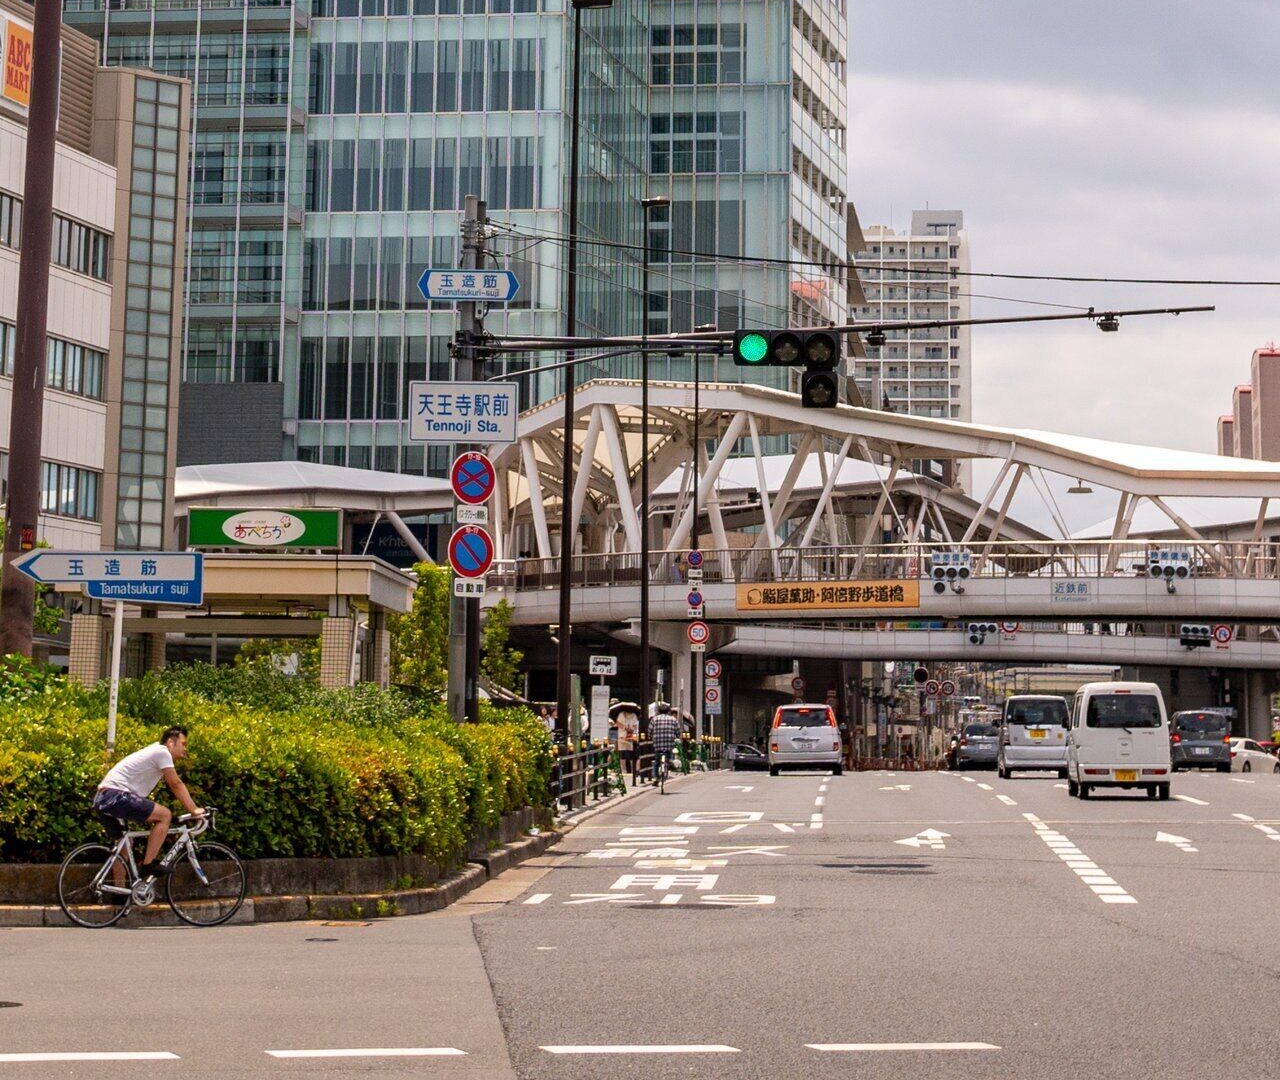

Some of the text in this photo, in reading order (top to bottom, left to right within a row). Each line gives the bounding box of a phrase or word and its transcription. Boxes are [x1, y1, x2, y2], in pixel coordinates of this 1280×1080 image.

[8, 34, 31, 72] ABC
[6, 66, 30, 94] MART
[440, 274, 498, 289] 玉造筋
[438, 287, 500, 298] Tamatsukuri-suji
[418, 393, 509, 417] 天王寺駅前
[425, 420, 502, 434] Tennoji Sta.
[234, 524, 286, 539] あべちか
[67, 559, 158, 576] 玉造筋
[99, 581, 189, 596] Tamatsukuri suji
[456, 583, 484, 593] 自動車
[1055, 583, 1088, 594] 近鉄前
[692, 628, 704, 638] 50
